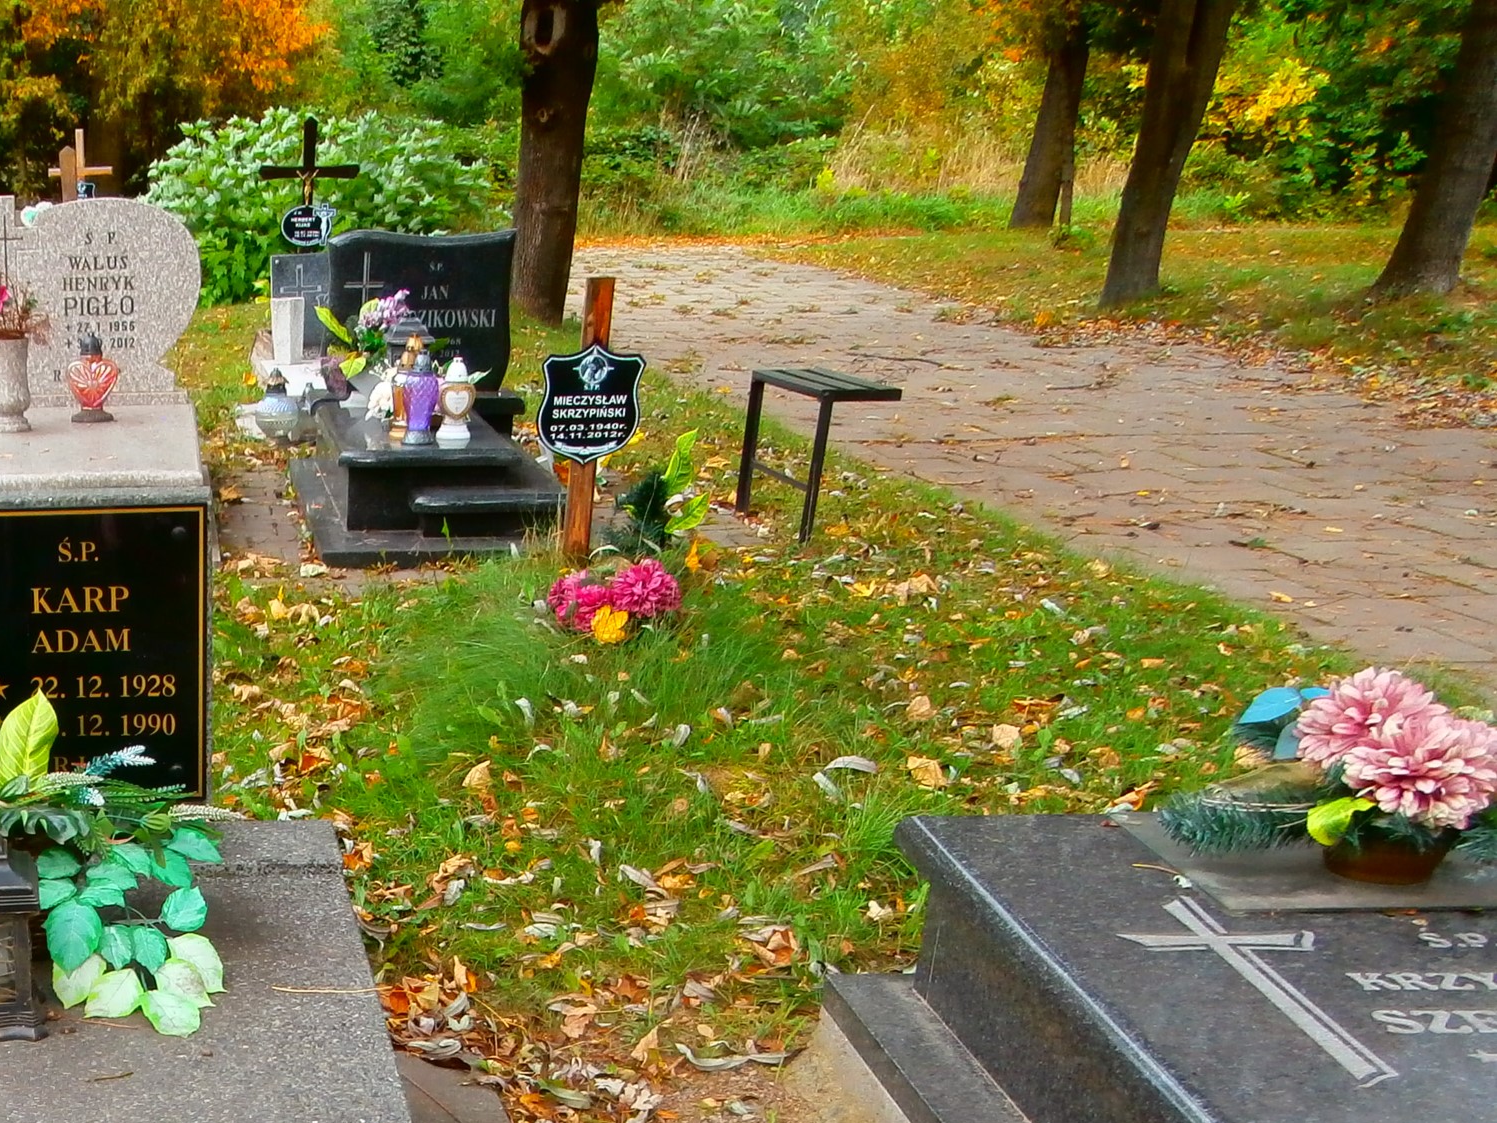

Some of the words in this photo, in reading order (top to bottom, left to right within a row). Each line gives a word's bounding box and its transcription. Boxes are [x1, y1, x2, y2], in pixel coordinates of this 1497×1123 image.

[63, 276, 136, 292] HENRYK
[421, 285, 449, 300] JAN
[64, 295, 135, 317] PIGŁO
[553, 395, 628, 406] MIECZYSŁAW
[552, 405, 626, 419] SKRZYPIŃSKI
[549, 422, 628, 432] 07.03.1940r.
[549, 430, 626, 440] 14.11.2012r.
[57, 536, 100, 563] Ś.P.
[30, 585, 130, 615] KARP
[31, 628, 131, 654] ADAM
[76, 676, 110, 699] 12.
[120, 674, 177, 698] 1928
[120, 713, 177, 737] 1990
